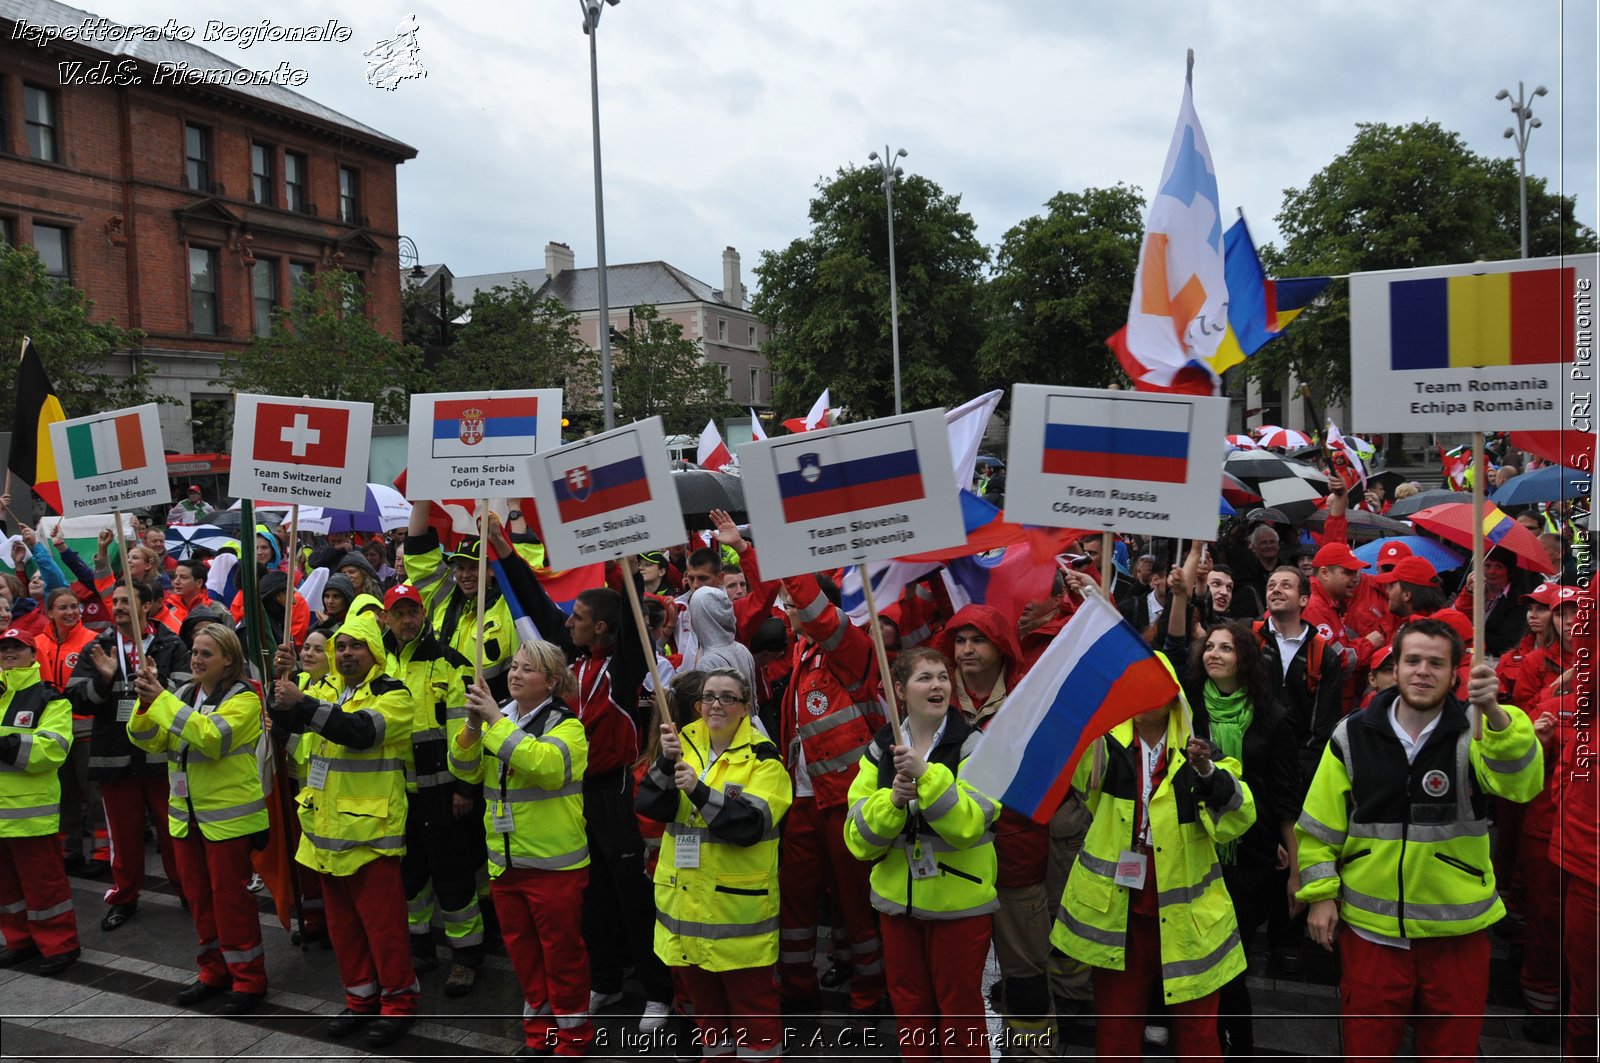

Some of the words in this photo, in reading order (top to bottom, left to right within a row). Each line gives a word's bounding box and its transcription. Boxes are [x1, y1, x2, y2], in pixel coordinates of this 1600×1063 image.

[1414, 381, 1462, 394] Team
[1468, 377, 1549, 392] Romania
[1410, 401, 1467, 416] Echipa
[1473, 398, 1554, 412] România
[254, 468, 280, 479] Team
[283, 470, 342, 485] Switzerland
[452, 465, 479, 474] Team
[482, 464, 515, 473] Serbia
[86, 482, 107, 493] Team
[109, 476, 139, 489] Ireland
[261, 483, 288, 494] Team
[290, 486, 332, 499] Schweiz
[450, 478, 485, 489] Србија
[489, 477, 515, 486] Теам
[73, 498, 107, 508] Foireann
[120, 488, 157, 500] hÉireann
[1067, 486, 1106, 499] Team
[1110, 489, 1158, 503] Russia
[1052, 502, 1114, 517] Сборная
[1118, 507, 1171, 521] России
[574, 526, 601, 539] Team
[603, 514, 646, 532] Slovakia
[807, 526, 847, 539] Team
[850, 513, 910, 532] Slovenia
[578, 544, 597, 555] Tim
[598, 531, 650, 550] Slovensko
[808, 543, 848, 557] Team
[850, 530, 915, 549] Slovenija
